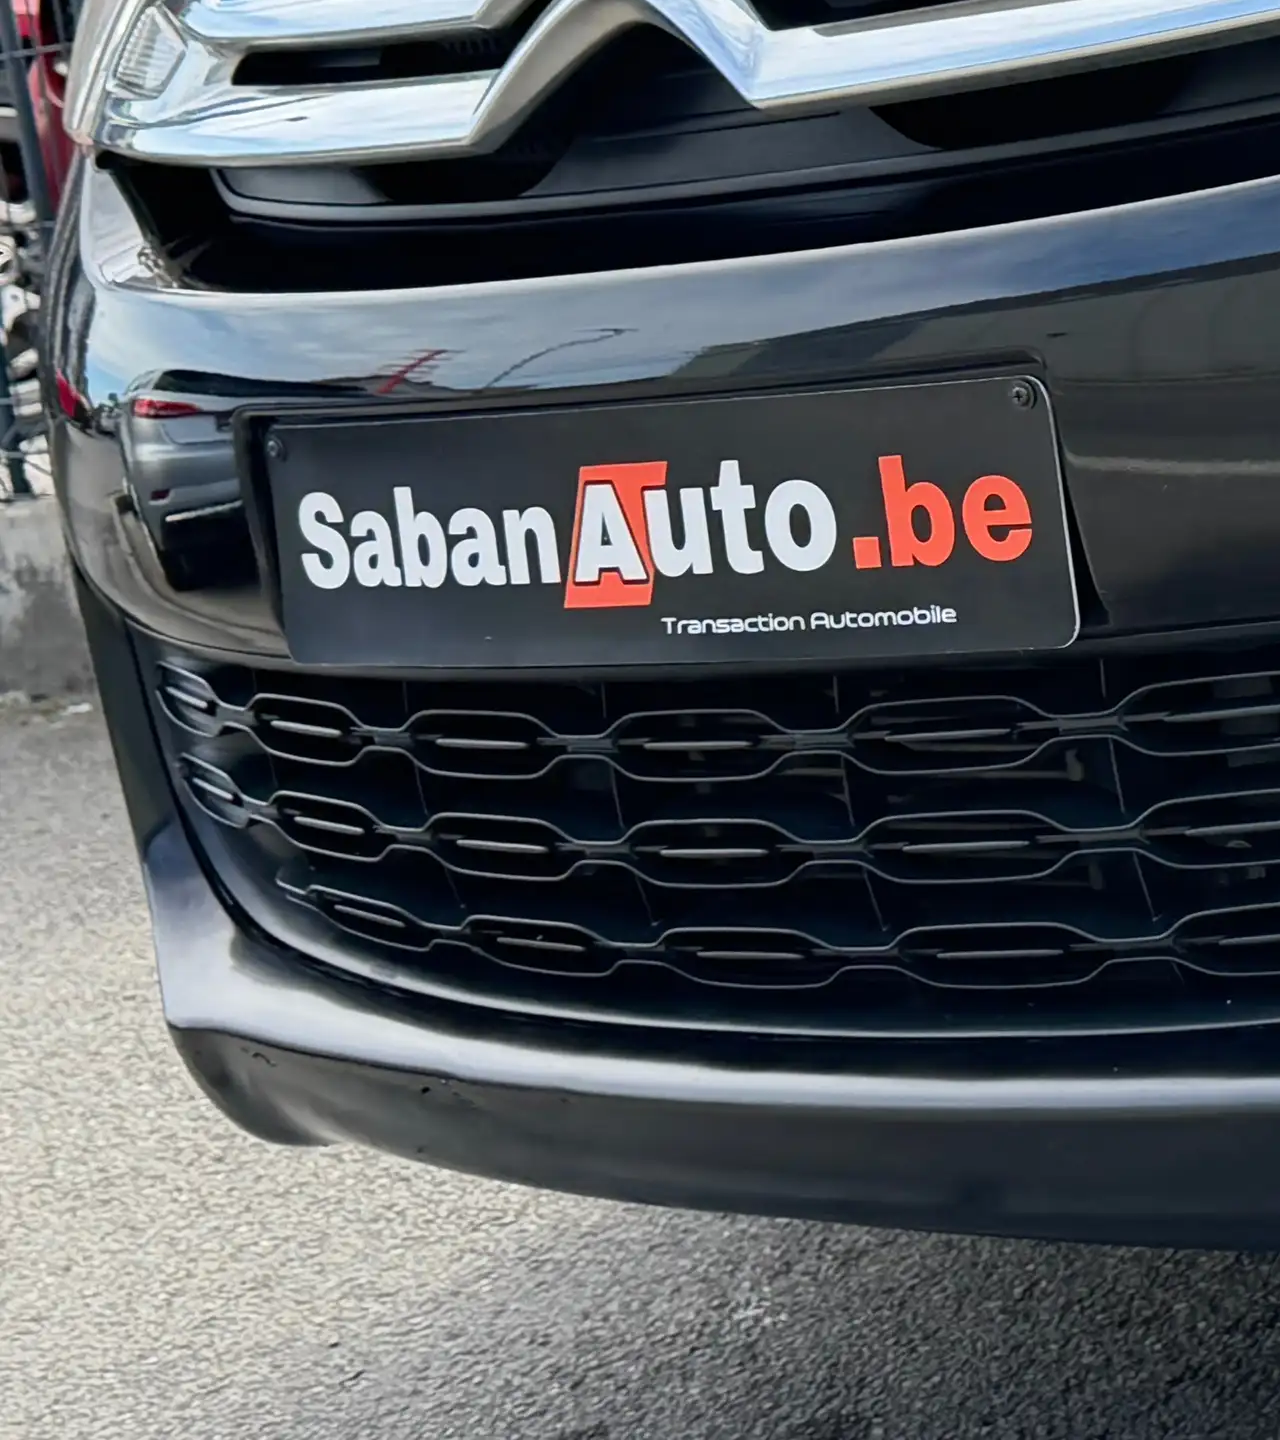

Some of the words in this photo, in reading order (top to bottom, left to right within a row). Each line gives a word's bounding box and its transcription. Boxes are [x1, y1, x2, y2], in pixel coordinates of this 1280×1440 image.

[298, 454, 1034, 596] SabanAuto.be
[660, 611, 806, 636] Transaction
[809, 603, 958, 632] Automobile
